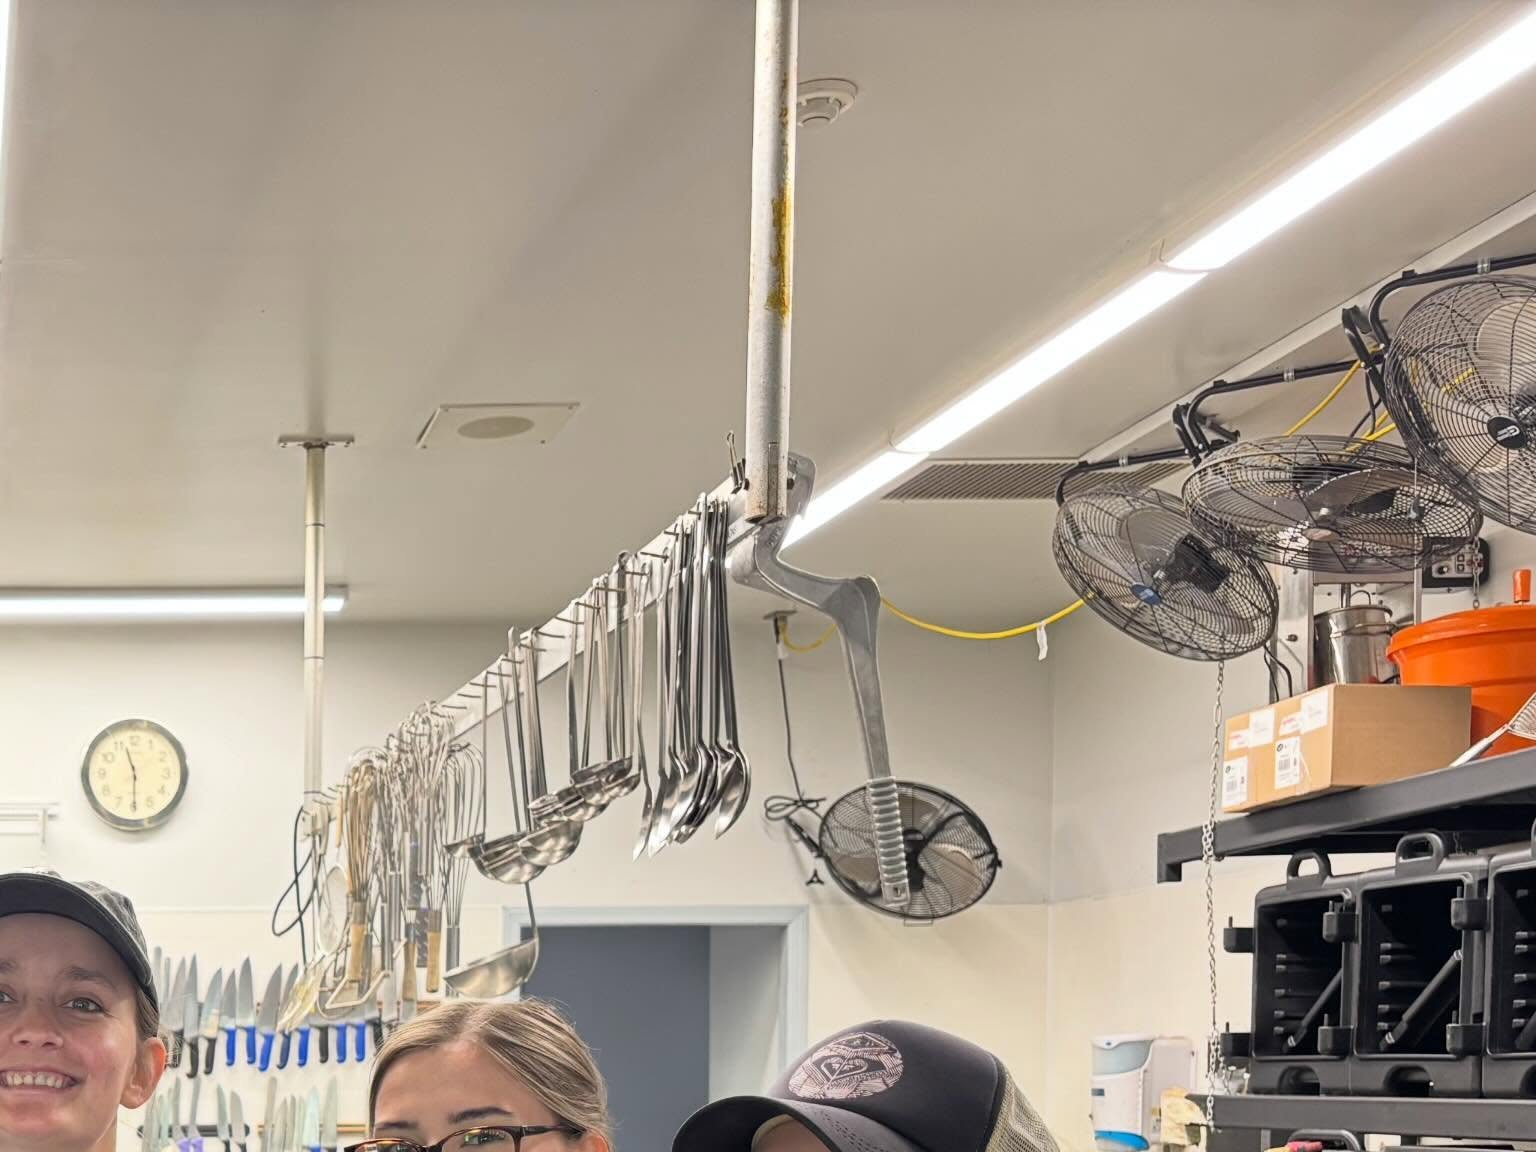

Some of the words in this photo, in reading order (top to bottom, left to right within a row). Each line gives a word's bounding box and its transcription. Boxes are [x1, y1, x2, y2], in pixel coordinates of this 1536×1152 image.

[114, 740, 123, 751] 11
[128, 735, 141, 746] 12
[162, 767, 171, 780] 3
[157, 784, 166, 795] 4
[115, 796, 124, 808] 7
